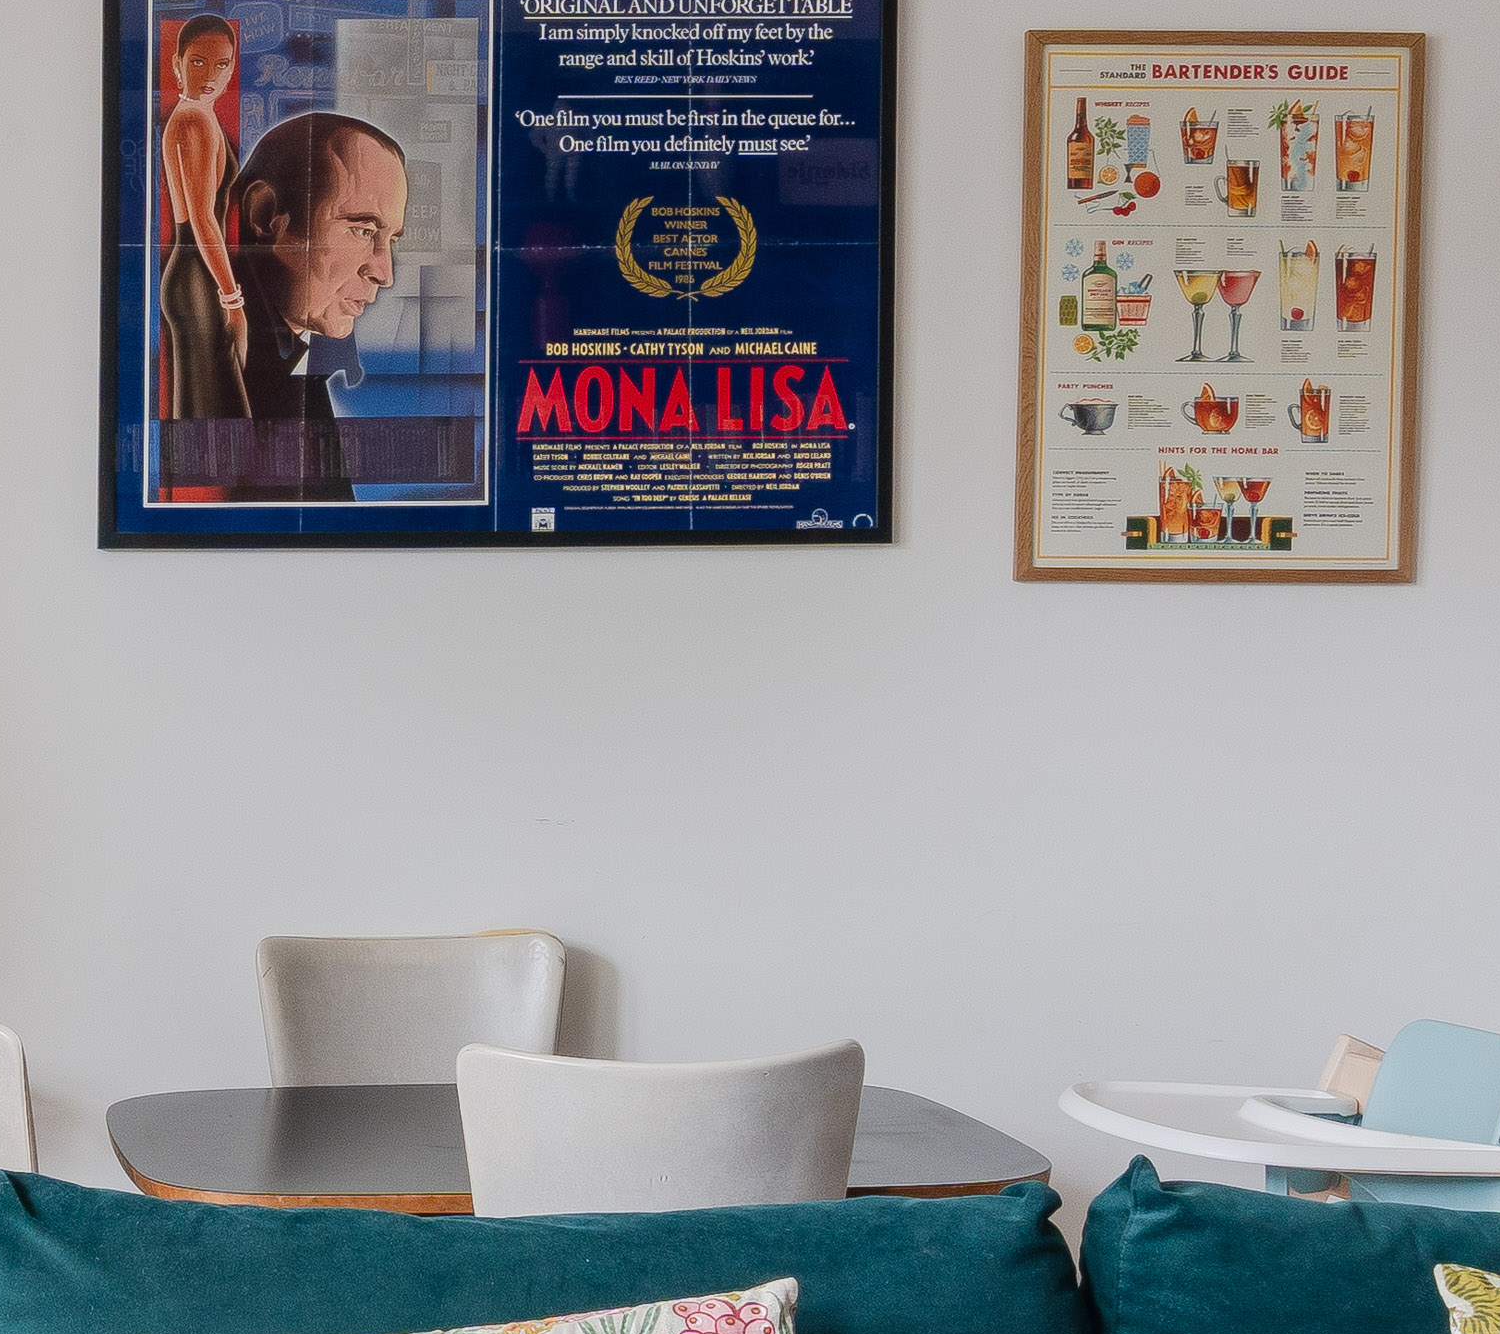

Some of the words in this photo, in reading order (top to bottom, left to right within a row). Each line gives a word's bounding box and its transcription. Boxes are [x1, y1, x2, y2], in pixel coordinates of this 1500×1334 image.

[539, 23, 546, 40] I
[548, 27, 574, 40] am
[576, 24, 629, 43] simply
[631, 24, 700, 40] knocked
[703, 24, 727, 40] off
[728, 27, 752, 43] my
[755, 24, 784, 40] feet
[786, 24, 805, 43] by
[808, 24, 833, 39] the
[559, 54, 604, 69] range
[607, 50, 637, 66] and
[640, 50, 673, 66] skill
[676, 49, 695, 66] of
[696, 50, 767, 66] Hoskins'
[1100, 71, 1146, 79] STANDARD
[1152, 64, 1279, 79] BARTENDER'S
[1288, 65, 1348, 81] GUIDE
[615, 75, 633, 84] REX
[634, 75, 657, 84] REED
[683, 75, 705, 84] YORK
[706, 75, 731, 84] DAILY
[733, 75, 757, 84] NEWS
[515, 110, 555, 127] 'One
[556, 110, 589, 127] film
[592, 114, 622, 128] you
[625, 112, 664, 126] must
[666, 110, 686, 126] be
[688, 110, 719, 126] first
[722, 110, 738, 126] in
[741, 110, 766, 126] the
[768, 114, 816, 128] queue
[559, 136, 593, 152] One
[596, 135, 629, 152] film
[632, 140, 661, 155] you
[664, 135, 735, 155] definitely
[738, 137, 777, 151] must
[674, 161, 685, 170] ON
[686, 161, 720, 170] SUNDAY
[651, 207, 673, 216] BOB
[675, 207, 720, 216] HOSKINS
[664, 221, 707, 229] WINNER
[653, 235, 677, 243] BEST
[682, 235, 718, 243] ACTOR
[664, 248, 707, 256] CANNES
[649, 261, 672, 270] FILM
[675, 261, 722, 270] FESTIVAL
[675, 275, 695, 284] 1986
[546, 342, 568, 356] BOB
[571, 342, 621, 356] HOSKINS
[630, 342, 665, 356] CATHY
[667, 342, 704, 356] TYSON
[709, 345, 731, 355] AND
[735, 342, 782, 356] MICHAEL
[784, 342, 817, 356] CAINE
[517, 365, 699, 432] MONA
[717, 365, 848, 432] LISA
[1158, 447, 1185, 455] HINTS
[1189, 447, 1207, 455] FOR
[1211, 447, 1227, 455] THE
[1231, 447, 1257, 455] HOME
[1261, 447, 1279, 455] BAR
